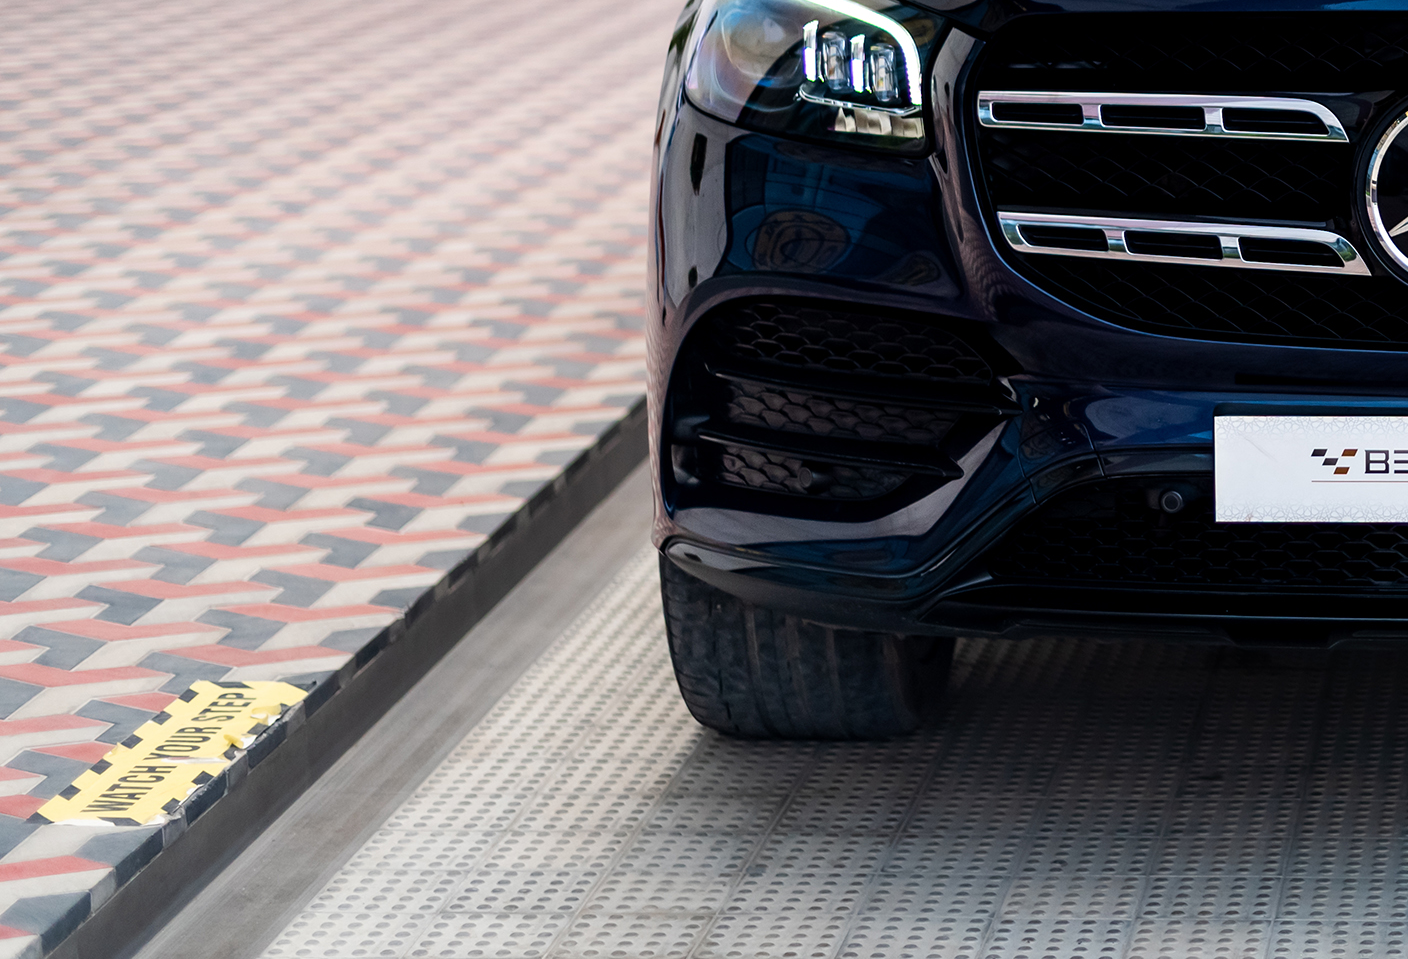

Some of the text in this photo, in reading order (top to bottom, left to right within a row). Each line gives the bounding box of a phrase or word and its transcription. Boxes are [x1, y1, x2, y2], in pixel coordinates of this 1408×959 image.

[80, 692, 257, 813] WATCH YOUR STEP
